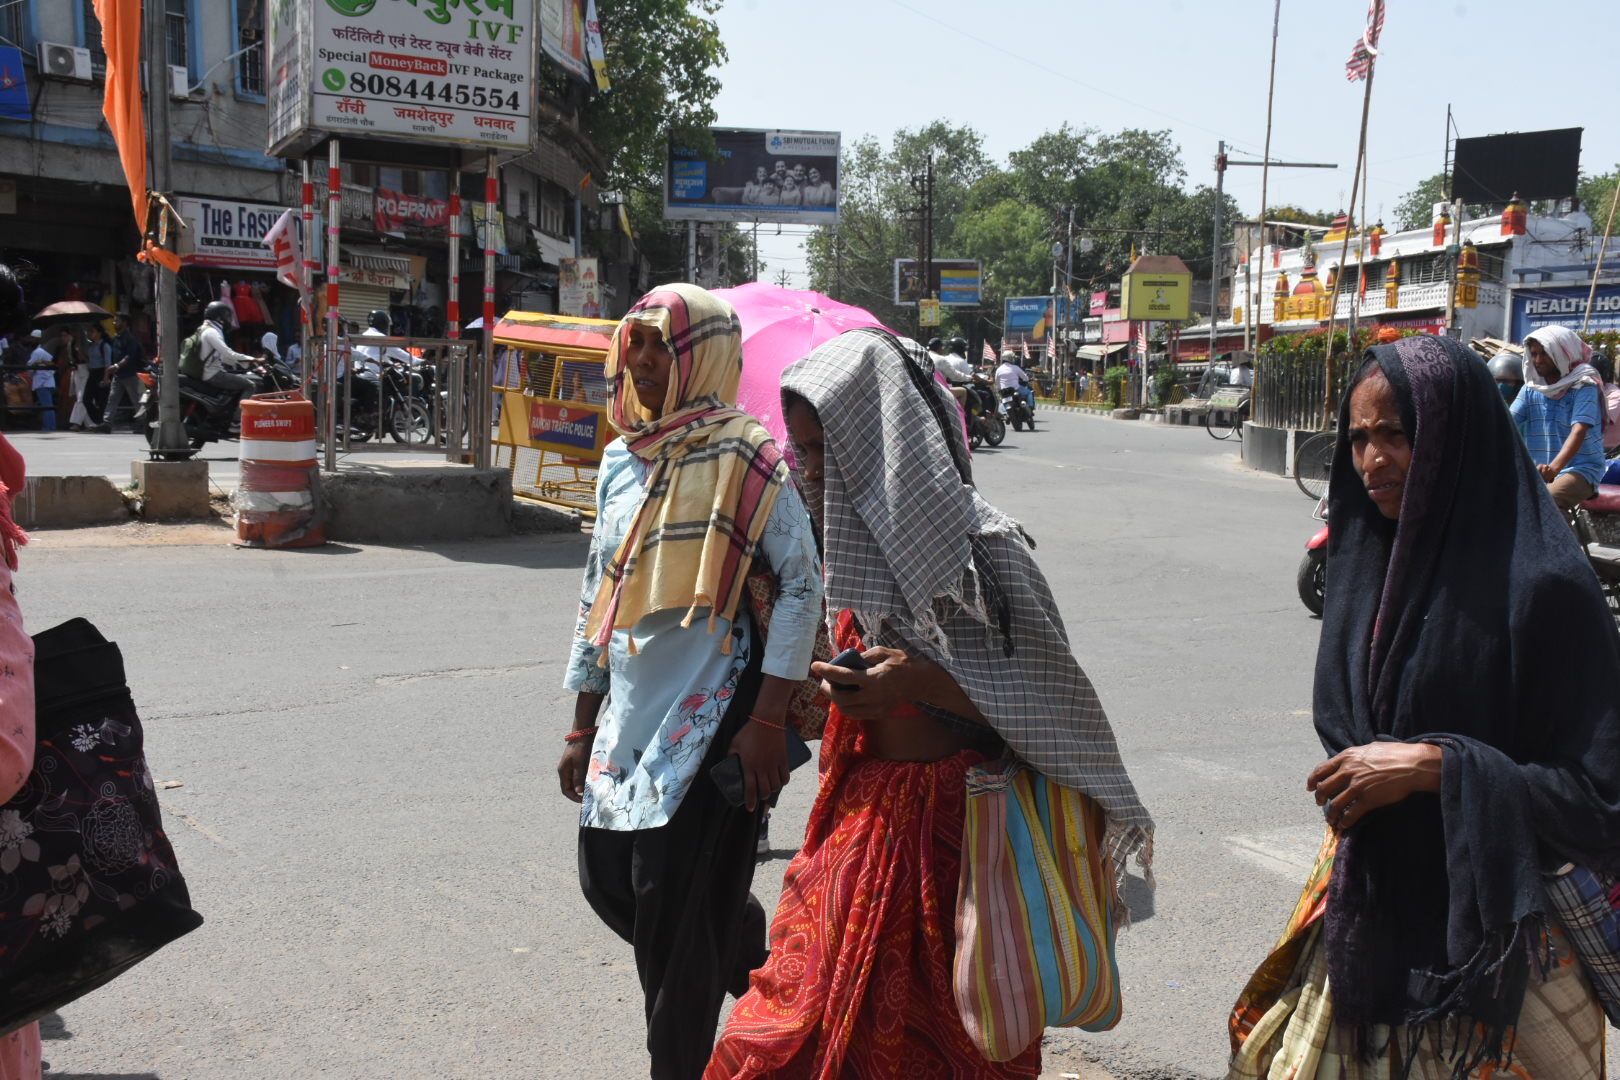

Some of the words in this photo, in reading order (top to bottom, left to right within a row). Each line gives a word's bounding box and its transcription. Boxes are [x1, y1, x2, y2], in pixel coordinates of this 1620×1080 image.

[332, 26, 384, 45] फर्टिलिटी
[388, 34, 405, 49] एवं
[410, 34, 431, 51] टेस्ट
[436, 41, 460, 60] ट्यूब
[463, 41, 484, 57] बेबी
[487, 45, 512, 61] सेंटर
[467, 18, 524, 45] IVF
[319, 48, 367, 64] Special
[370, 53, 446, 74] MoneyBack
[448, 63, 470, 75] IVF
[474, 67, 524, 83] Package
[350, 71, 520, 111] 8084445554
[335, 97, 367, 116] राँची
[393, 106, 455, 128] जमशेदपुर
[473, 116, 516, 133] धनबाद
[819, 137, 835, 145] FUND
[1525, 297, 1590, 314] HEALTH
[532, 416, 551, 431] RANCHI
[552, 419, 574, 435] TRAFFIC
[574, 423, 594, 439] POLICE
